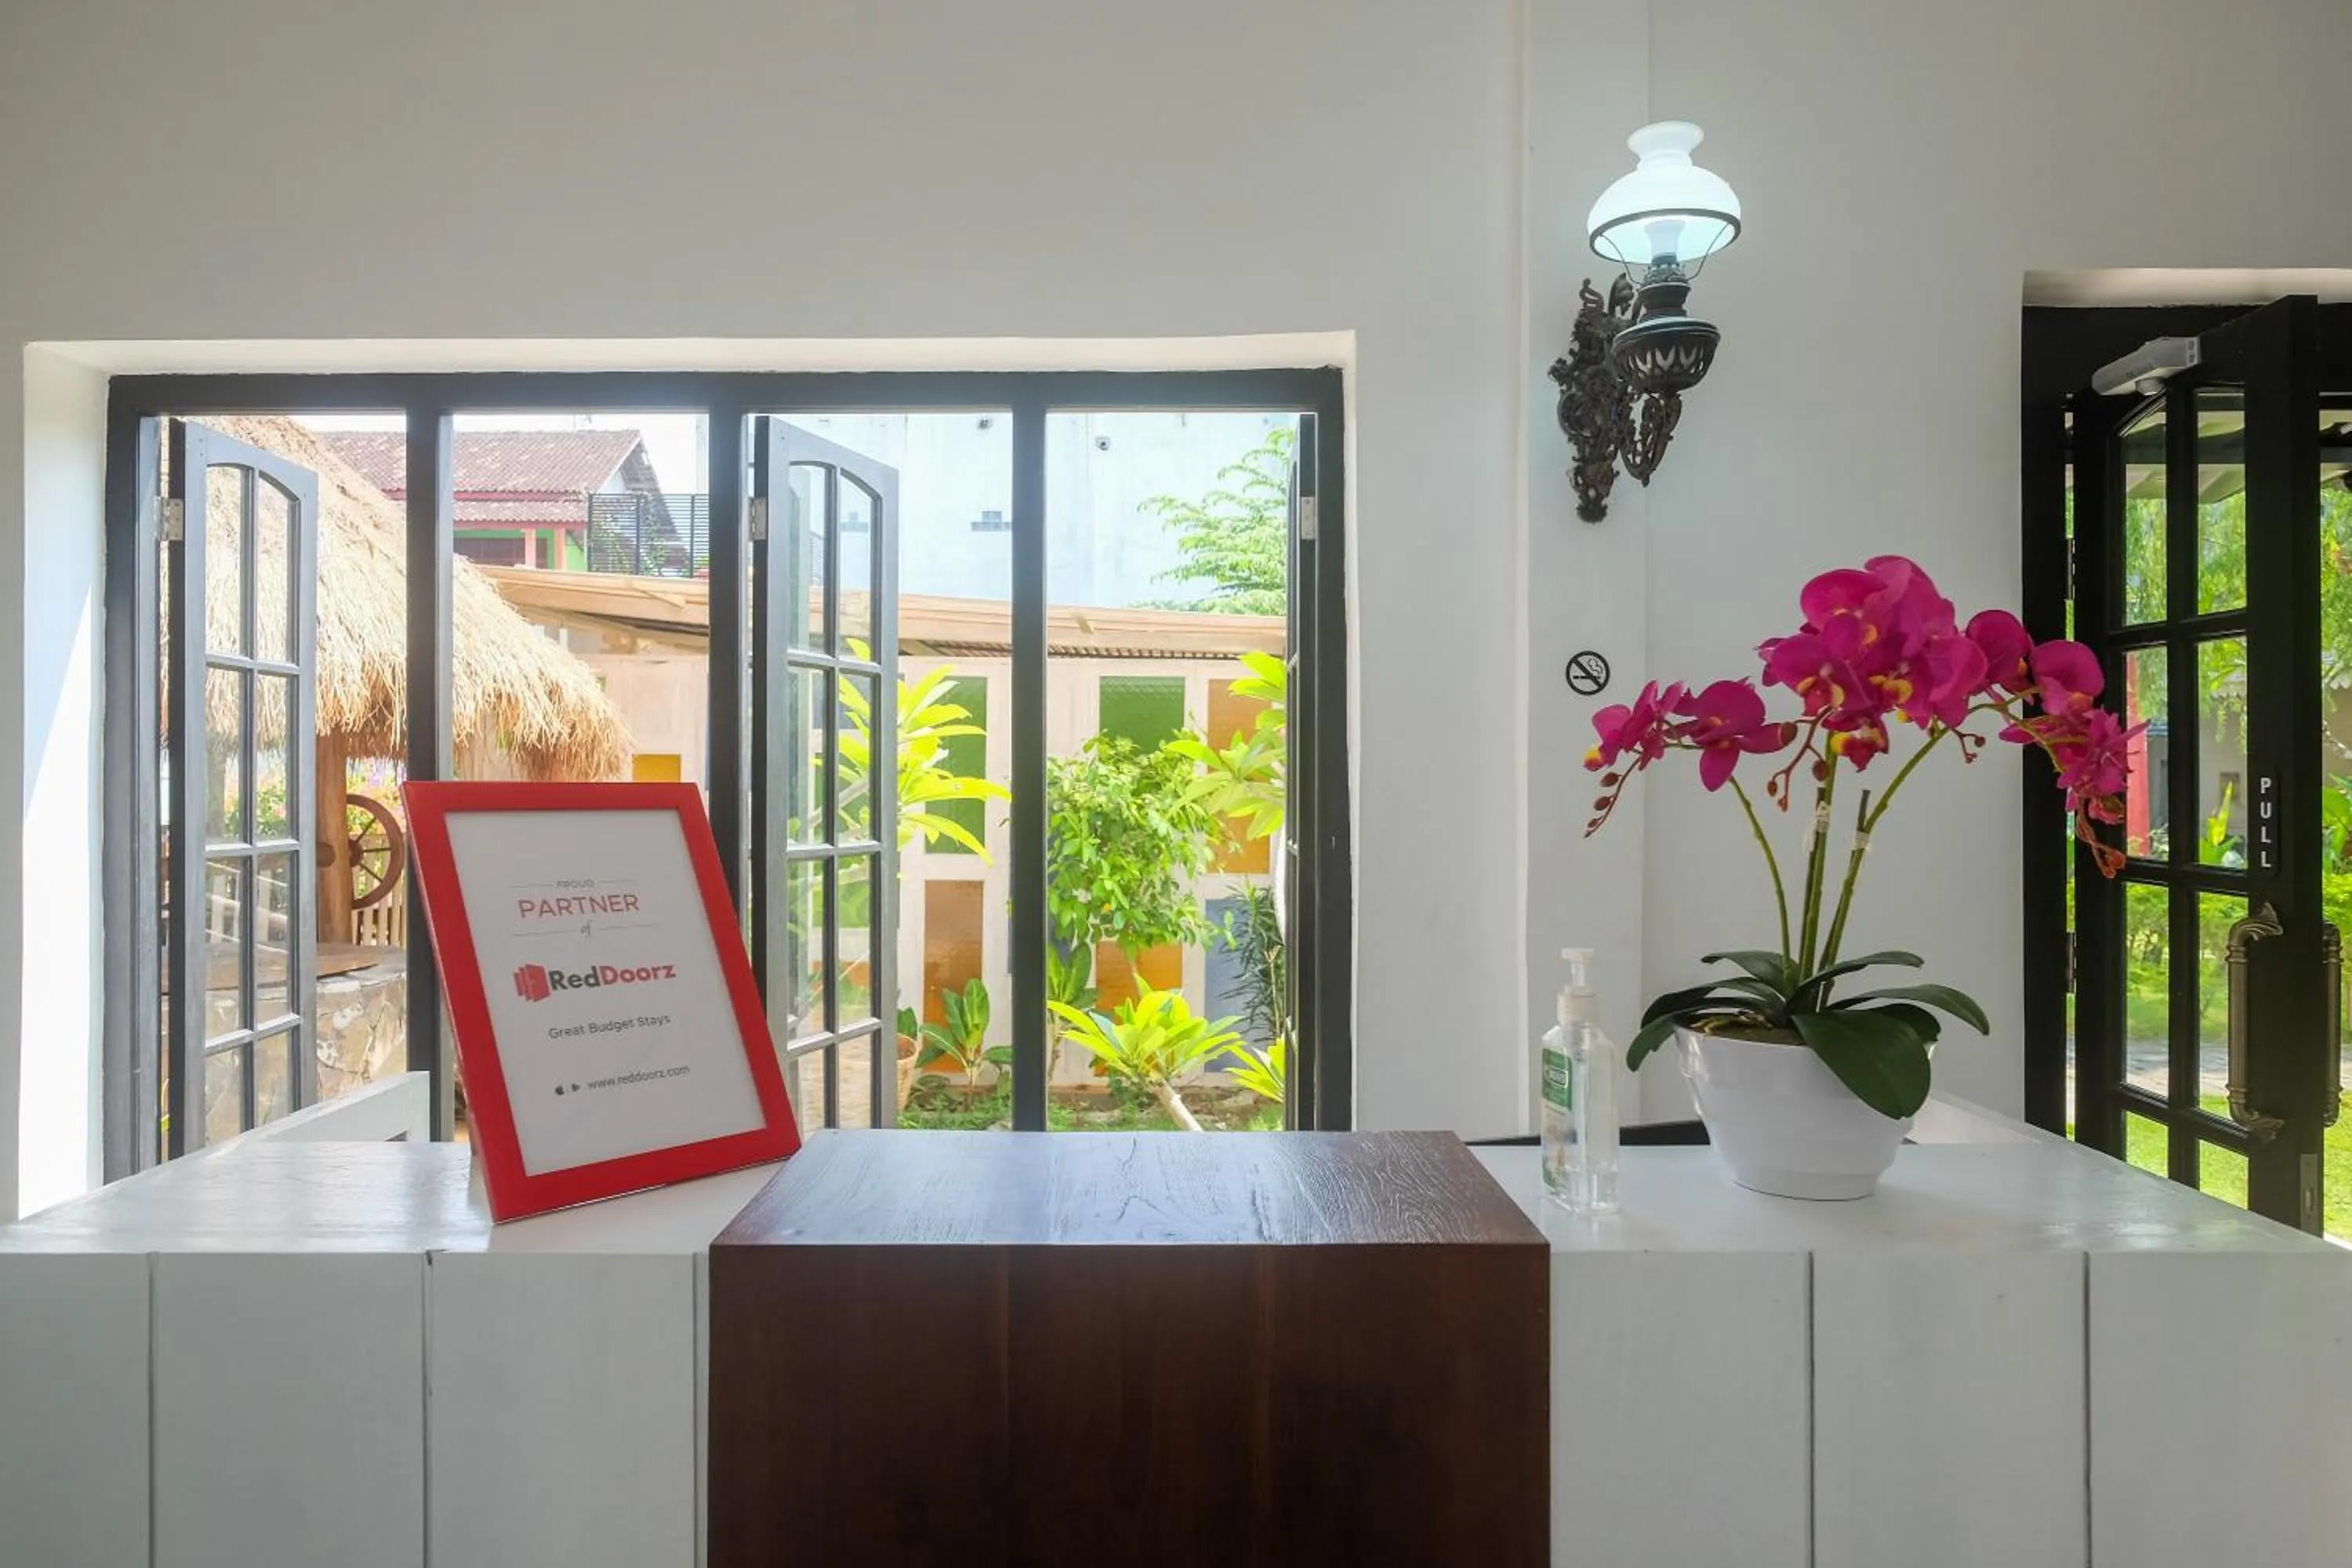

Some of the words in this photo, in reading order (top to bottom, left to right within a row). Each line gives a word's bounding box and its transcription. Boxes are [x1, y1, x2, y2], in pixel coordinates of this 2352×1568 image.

[2260, 777, 2272, 868] PULL
[518, 893, 640, 918] PARTNER
[581, 920, 592, 938] of
[549, 964, 677, 991] RedDoorz
[549, 1025, 585, 1039] Great
[589, 1019, 634, 1034] Budget
[637, 1015, 672, 1027] Stays
[588, 1065, 690, 1089] www.reddoorz.com
